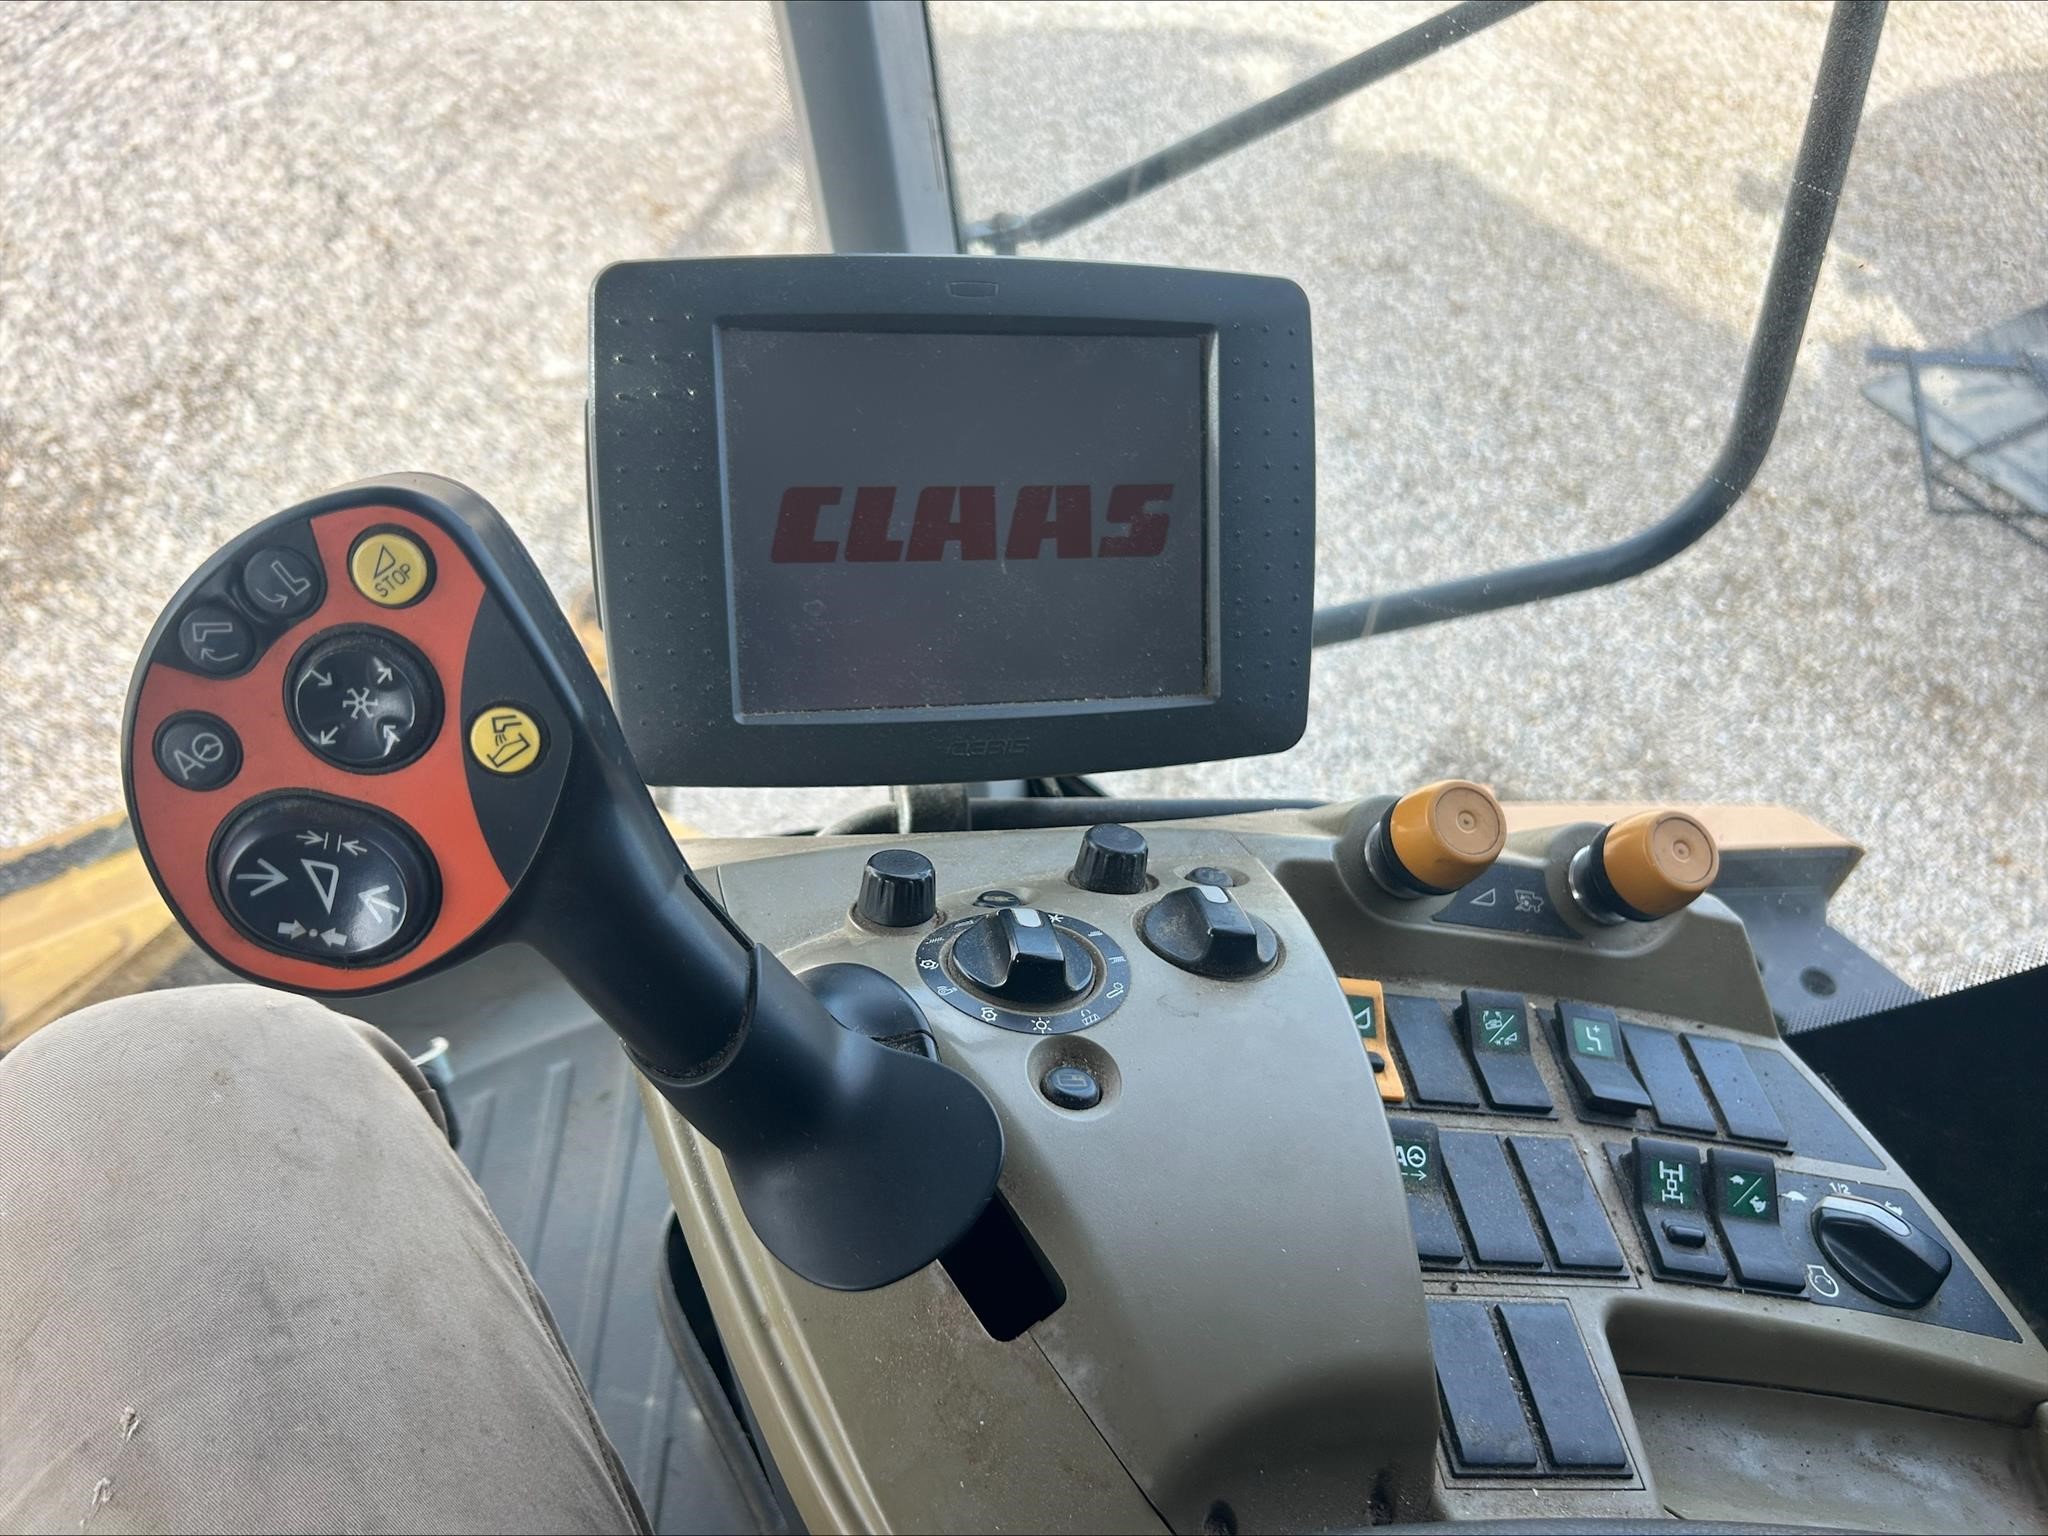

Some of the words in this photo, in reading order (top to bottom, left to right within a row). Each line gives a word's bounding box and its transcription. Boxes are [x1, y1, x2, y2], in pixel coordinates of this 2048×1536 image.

[770, 484, 1174, 564] CLAAS
[374, 563, 411, 598] STOP
[1829, 1182, 1852, 1195] 1/2
